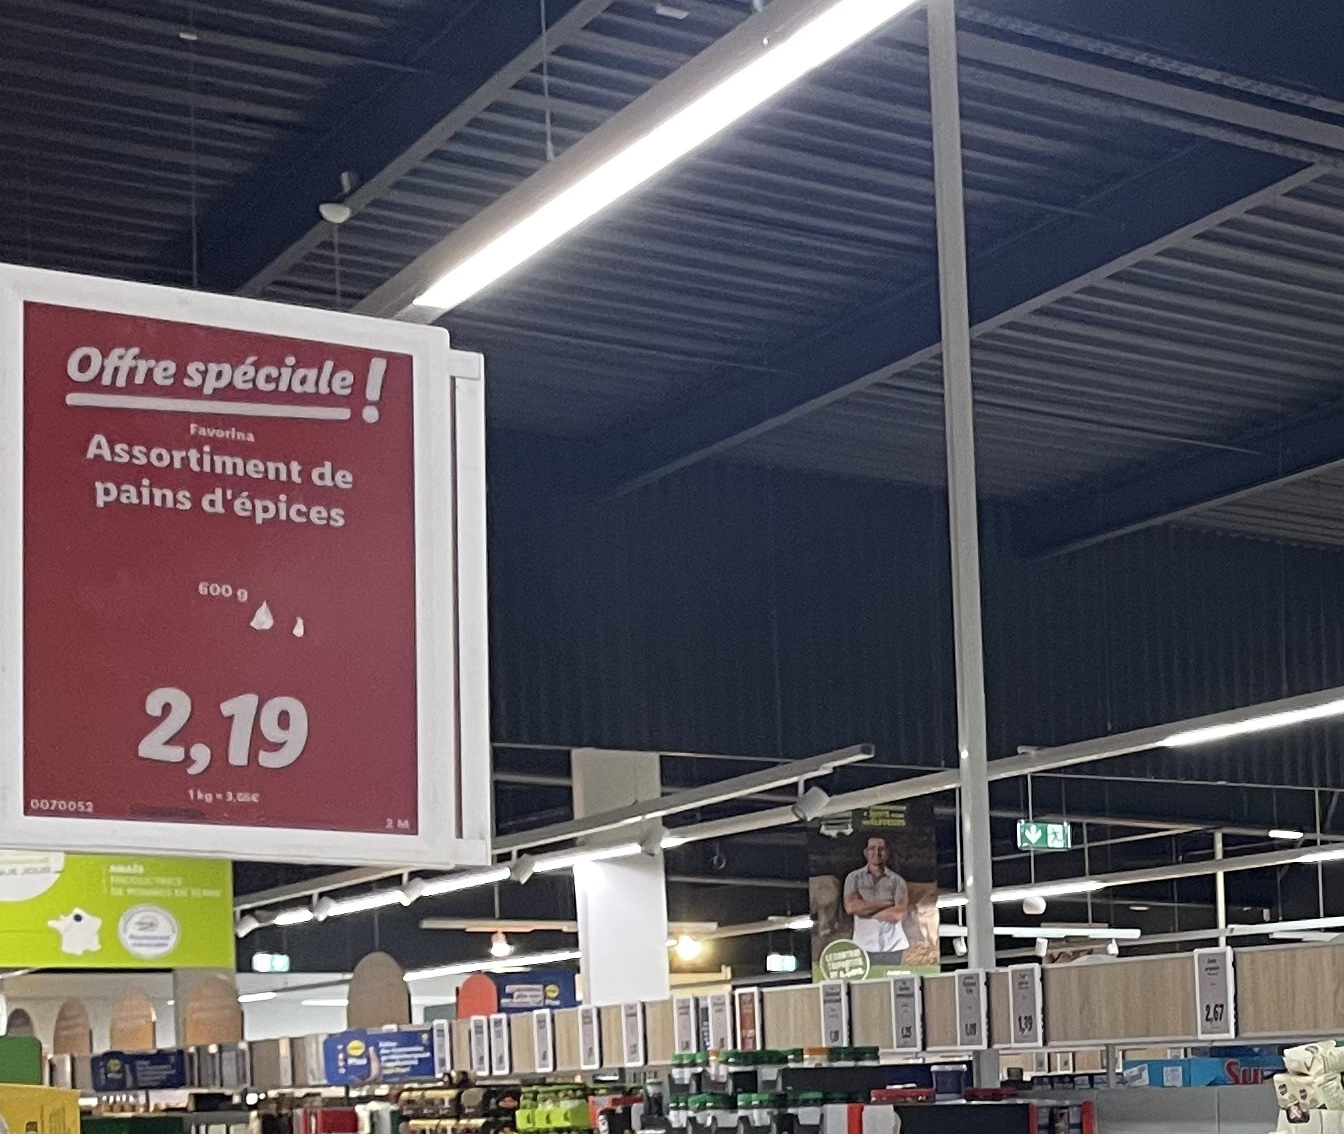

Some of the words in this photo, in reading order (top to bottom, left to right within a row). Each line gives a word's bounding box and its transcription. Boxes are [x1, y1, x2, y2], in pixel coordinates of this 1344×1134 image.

[66, 345, 175, 388] Offre
[184, 355, 355, 396] spéciale
[190, 423, 255, 443] Favorina
[86, 434, 303, 484] Assortiment
[311, 460, 354, 490] de
[95, 478, 192, 513] pains
[201, 486, 346, 528] d'épices
[138, 686, 309, 775] 2,19
[1205, 1003, 1225, 1024] 2,67
